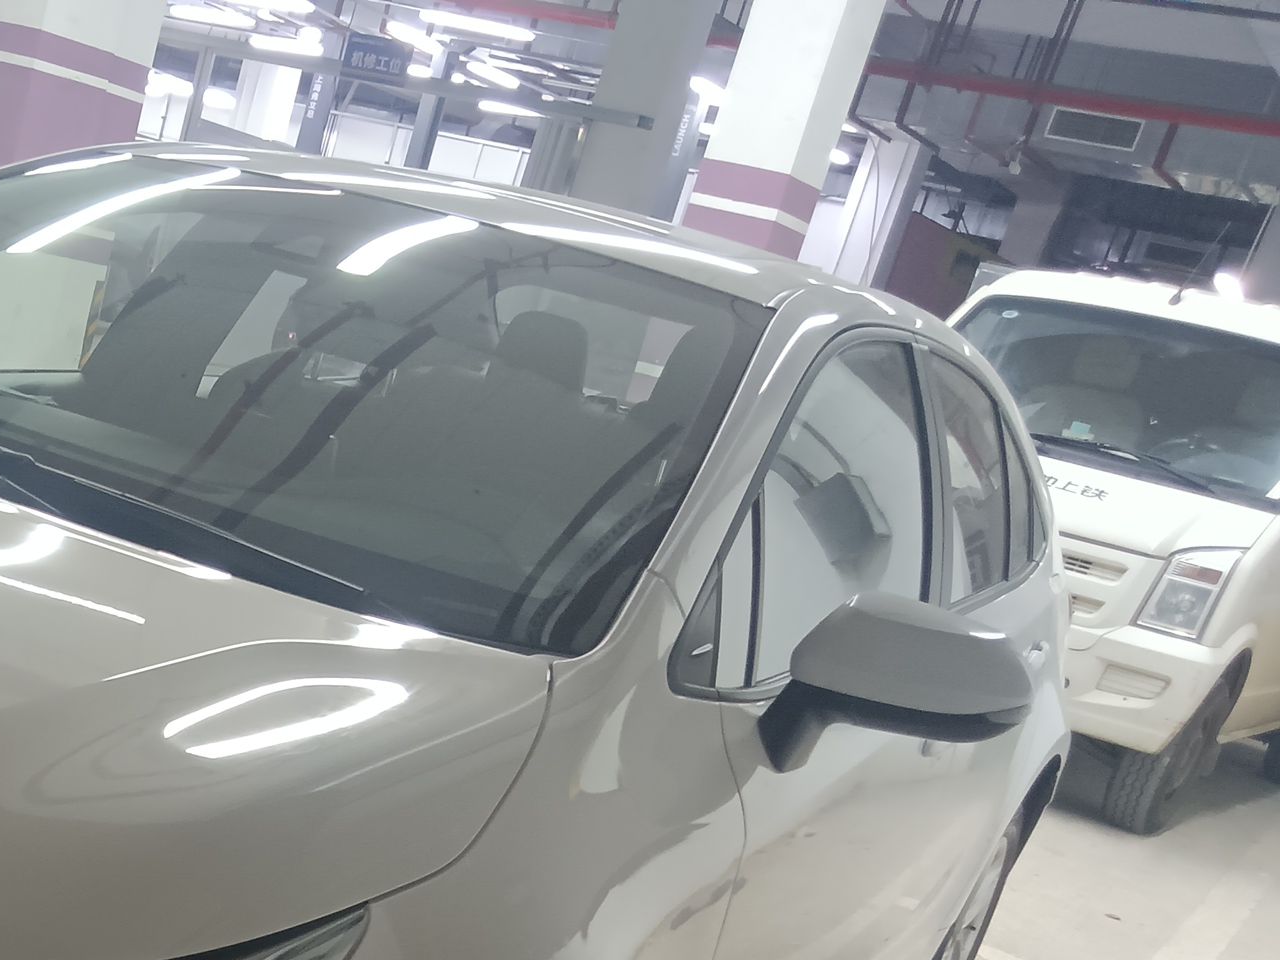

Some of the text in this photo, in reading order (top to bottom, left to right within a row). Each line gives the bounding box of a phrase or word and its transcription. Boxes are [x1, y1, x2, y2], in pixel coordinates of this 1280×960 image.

[351, 50, 402, 74] 机修工位
[671, 114, 690, 156] LAUNCH
